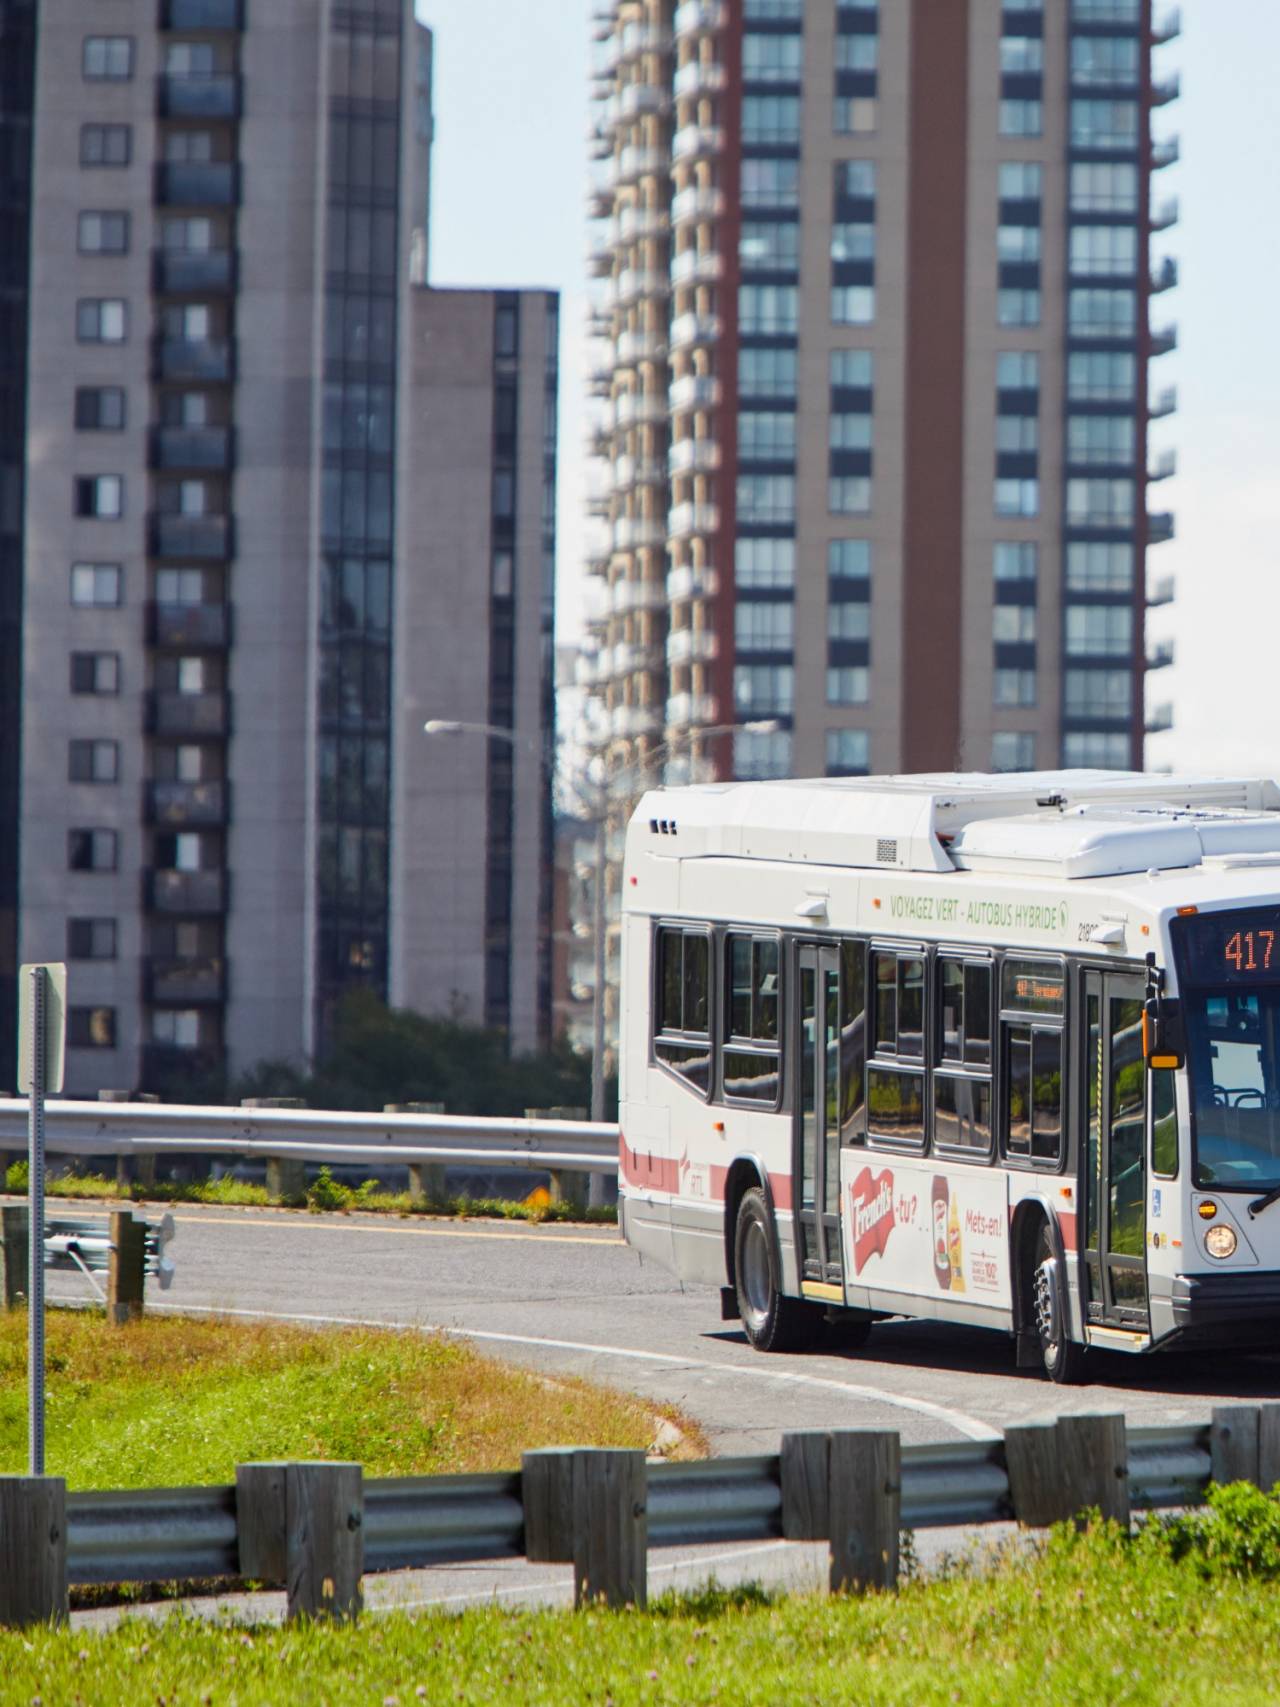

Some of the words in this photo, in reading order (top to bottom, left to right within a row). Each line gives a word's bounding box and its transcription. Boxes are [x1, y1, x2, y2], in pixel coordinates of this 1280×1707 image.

[890, 896, 933, 920] VOYAGEZ
[935, 899, 959, 922] VERT
[967, 902, 1013, 927] AUTOBUS
[1015, 905, 1057, 930] HYBRIDE
[1078, 922, 1099, 942] 218
[1225, 930, 1275, 970] 417
